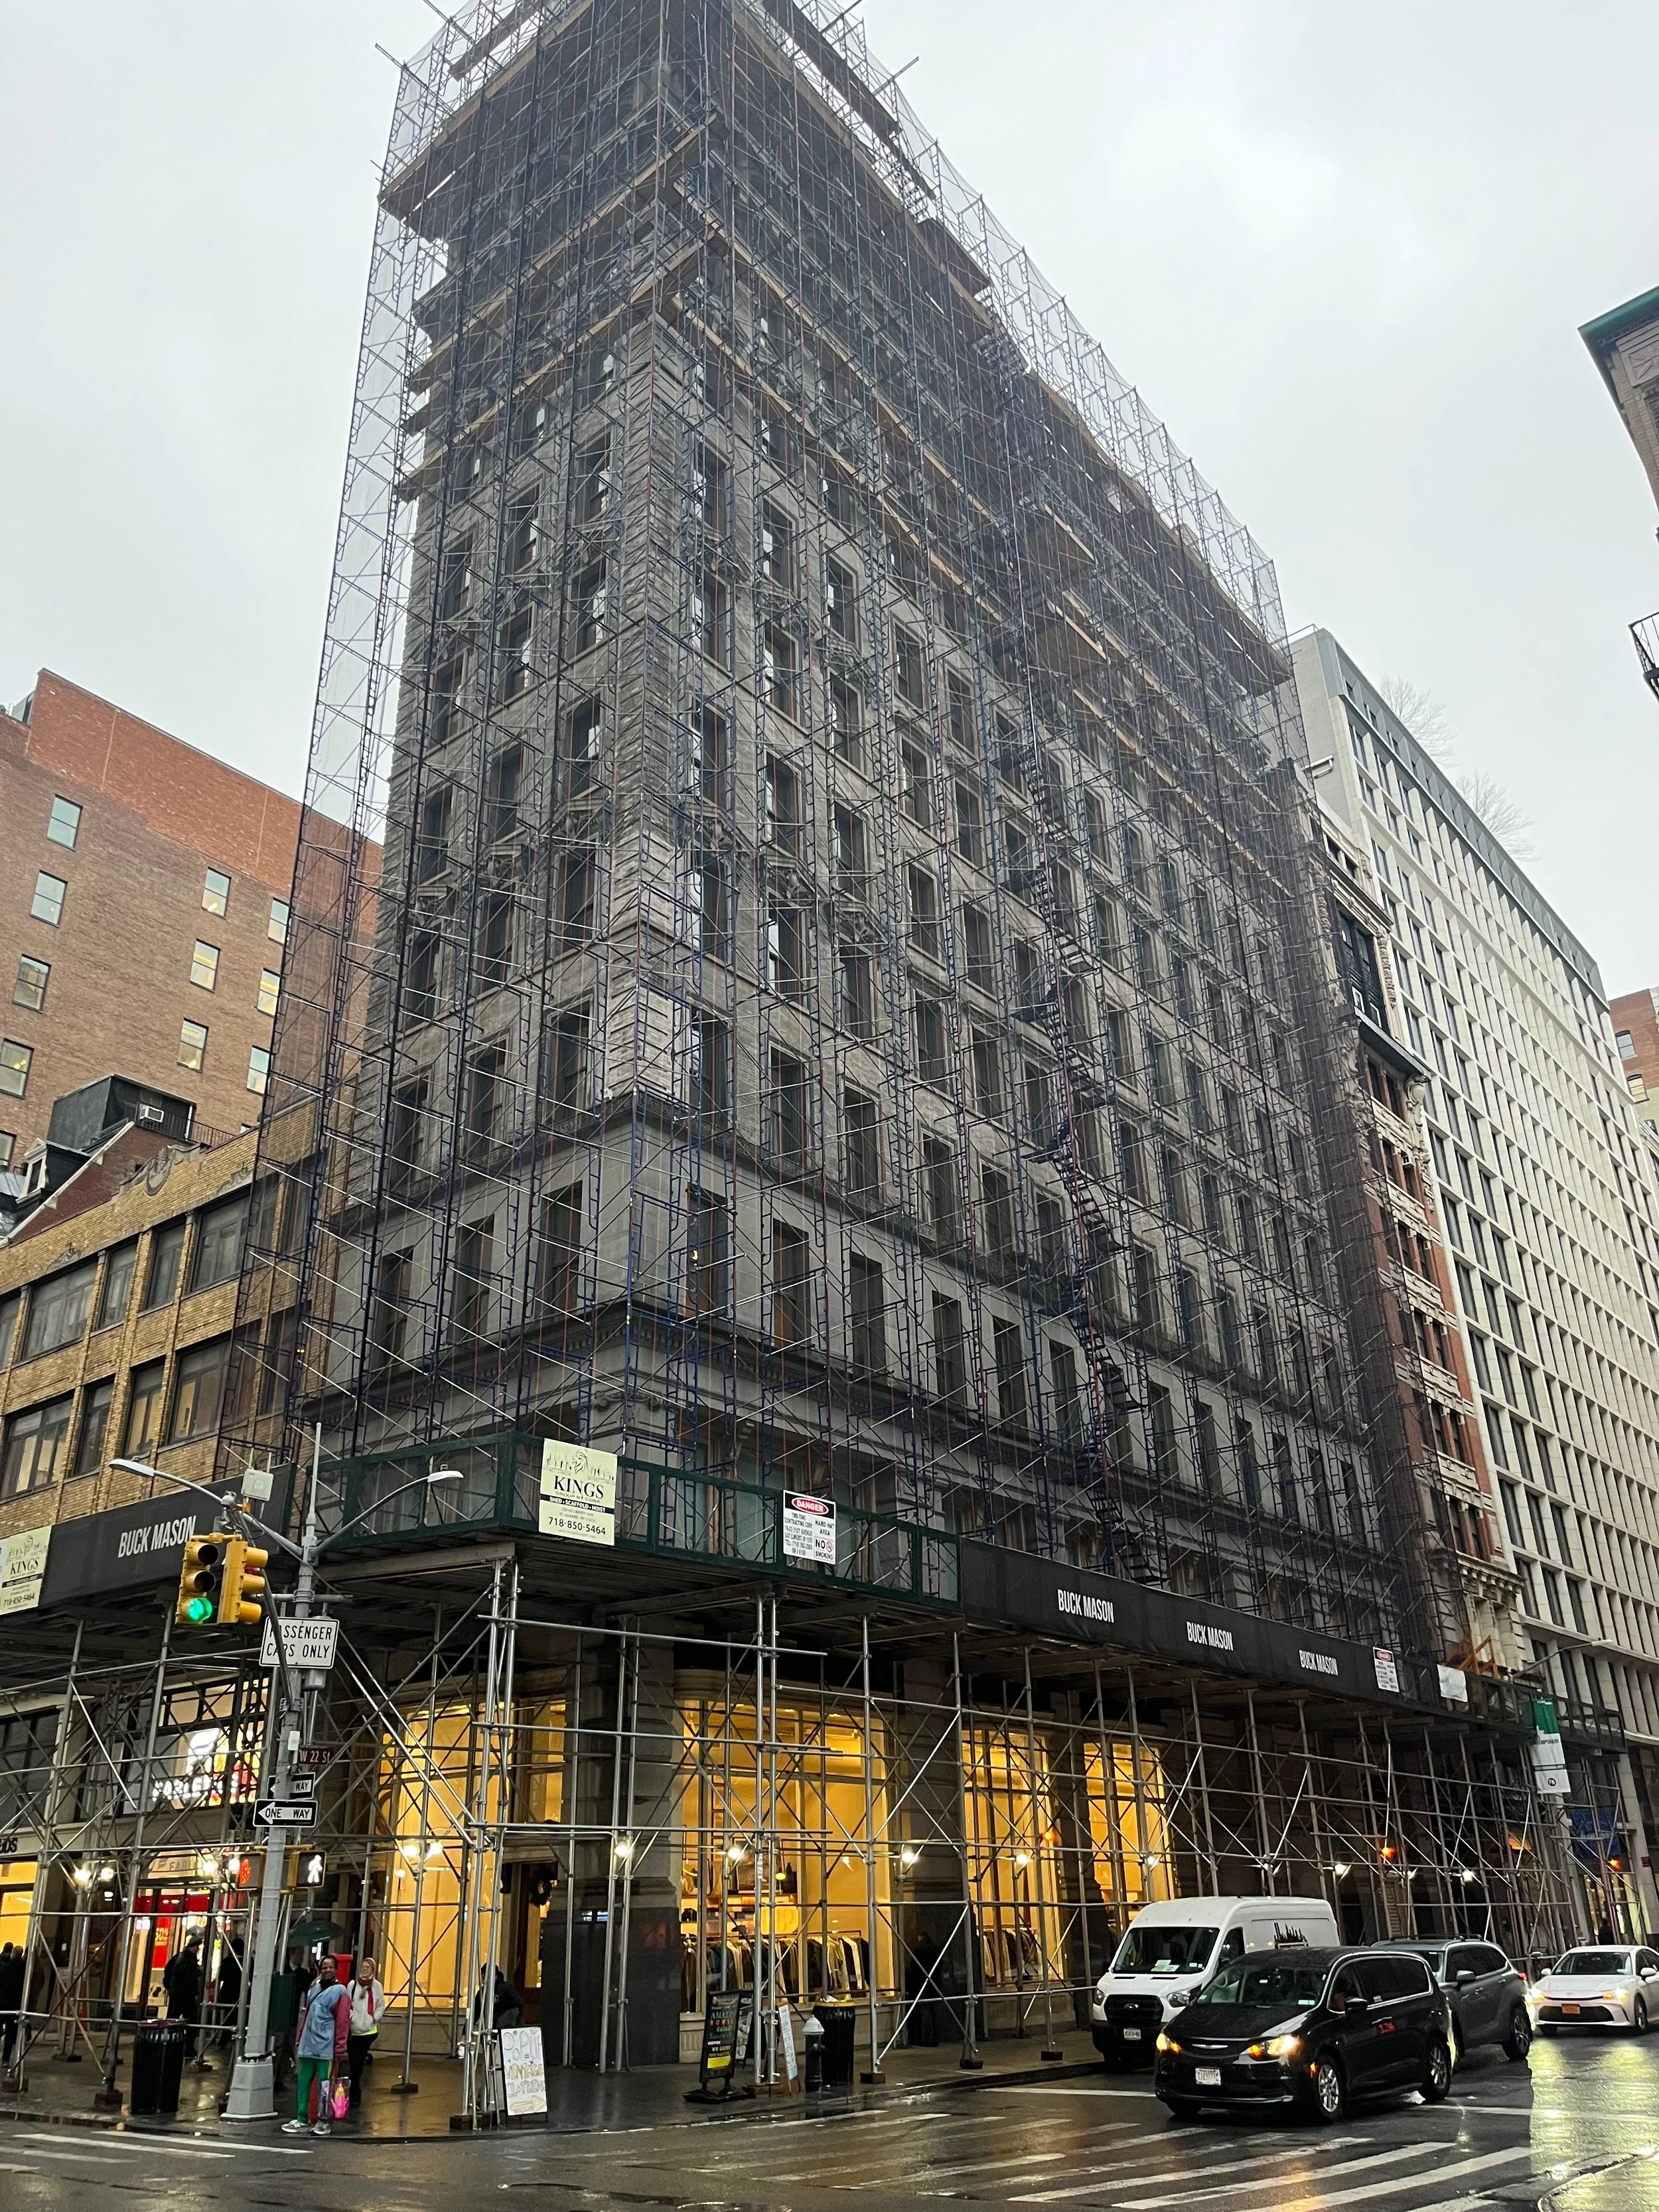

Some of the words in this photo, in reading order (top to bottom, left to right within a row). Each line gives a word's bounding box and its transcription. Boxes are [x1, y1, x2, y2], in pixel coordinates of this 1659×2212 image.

[554, 1475, 604, 1499] KINGS
[565, 1500, 589, 1509] SCAFFOLD
[796, 1500, 824, 1512] DANGER
[549, 1516, 606, 1535] 718-850-5464
[117, 1526, 152, 1558] BUCK
[151, 1515, 196, 1551] MASON
[816, 1539, 826, 1550] NO
[816, 1551, 833, 1560] SMOKING
[11, 1556, 40, 1576] KINGS
[1057, 1589, 1082, 1616] BUCK
[1082, 1595, 1114, 1623] MASON
[269, 1624, 332, 1640] SSENGER
[1187, 1621, 1208, 1645] BUCK
[1207, 1626, 1234, 1651] MASON
[303, 1644, 330, 1659] ONLY
[1299, 1649, 1317, 1671] BUCK
[1315, 1653, 1338, 1676] MASON
[299, 1750, 308, 1762] W
[310, 1751, 319, 1763] 22
[322, 1751, 330, 1763] St
[295, 1781, 309, 1791] WAY
[265, 1808, 282, 1818] ONE
[293, 1808, 310, 1818] WAY
